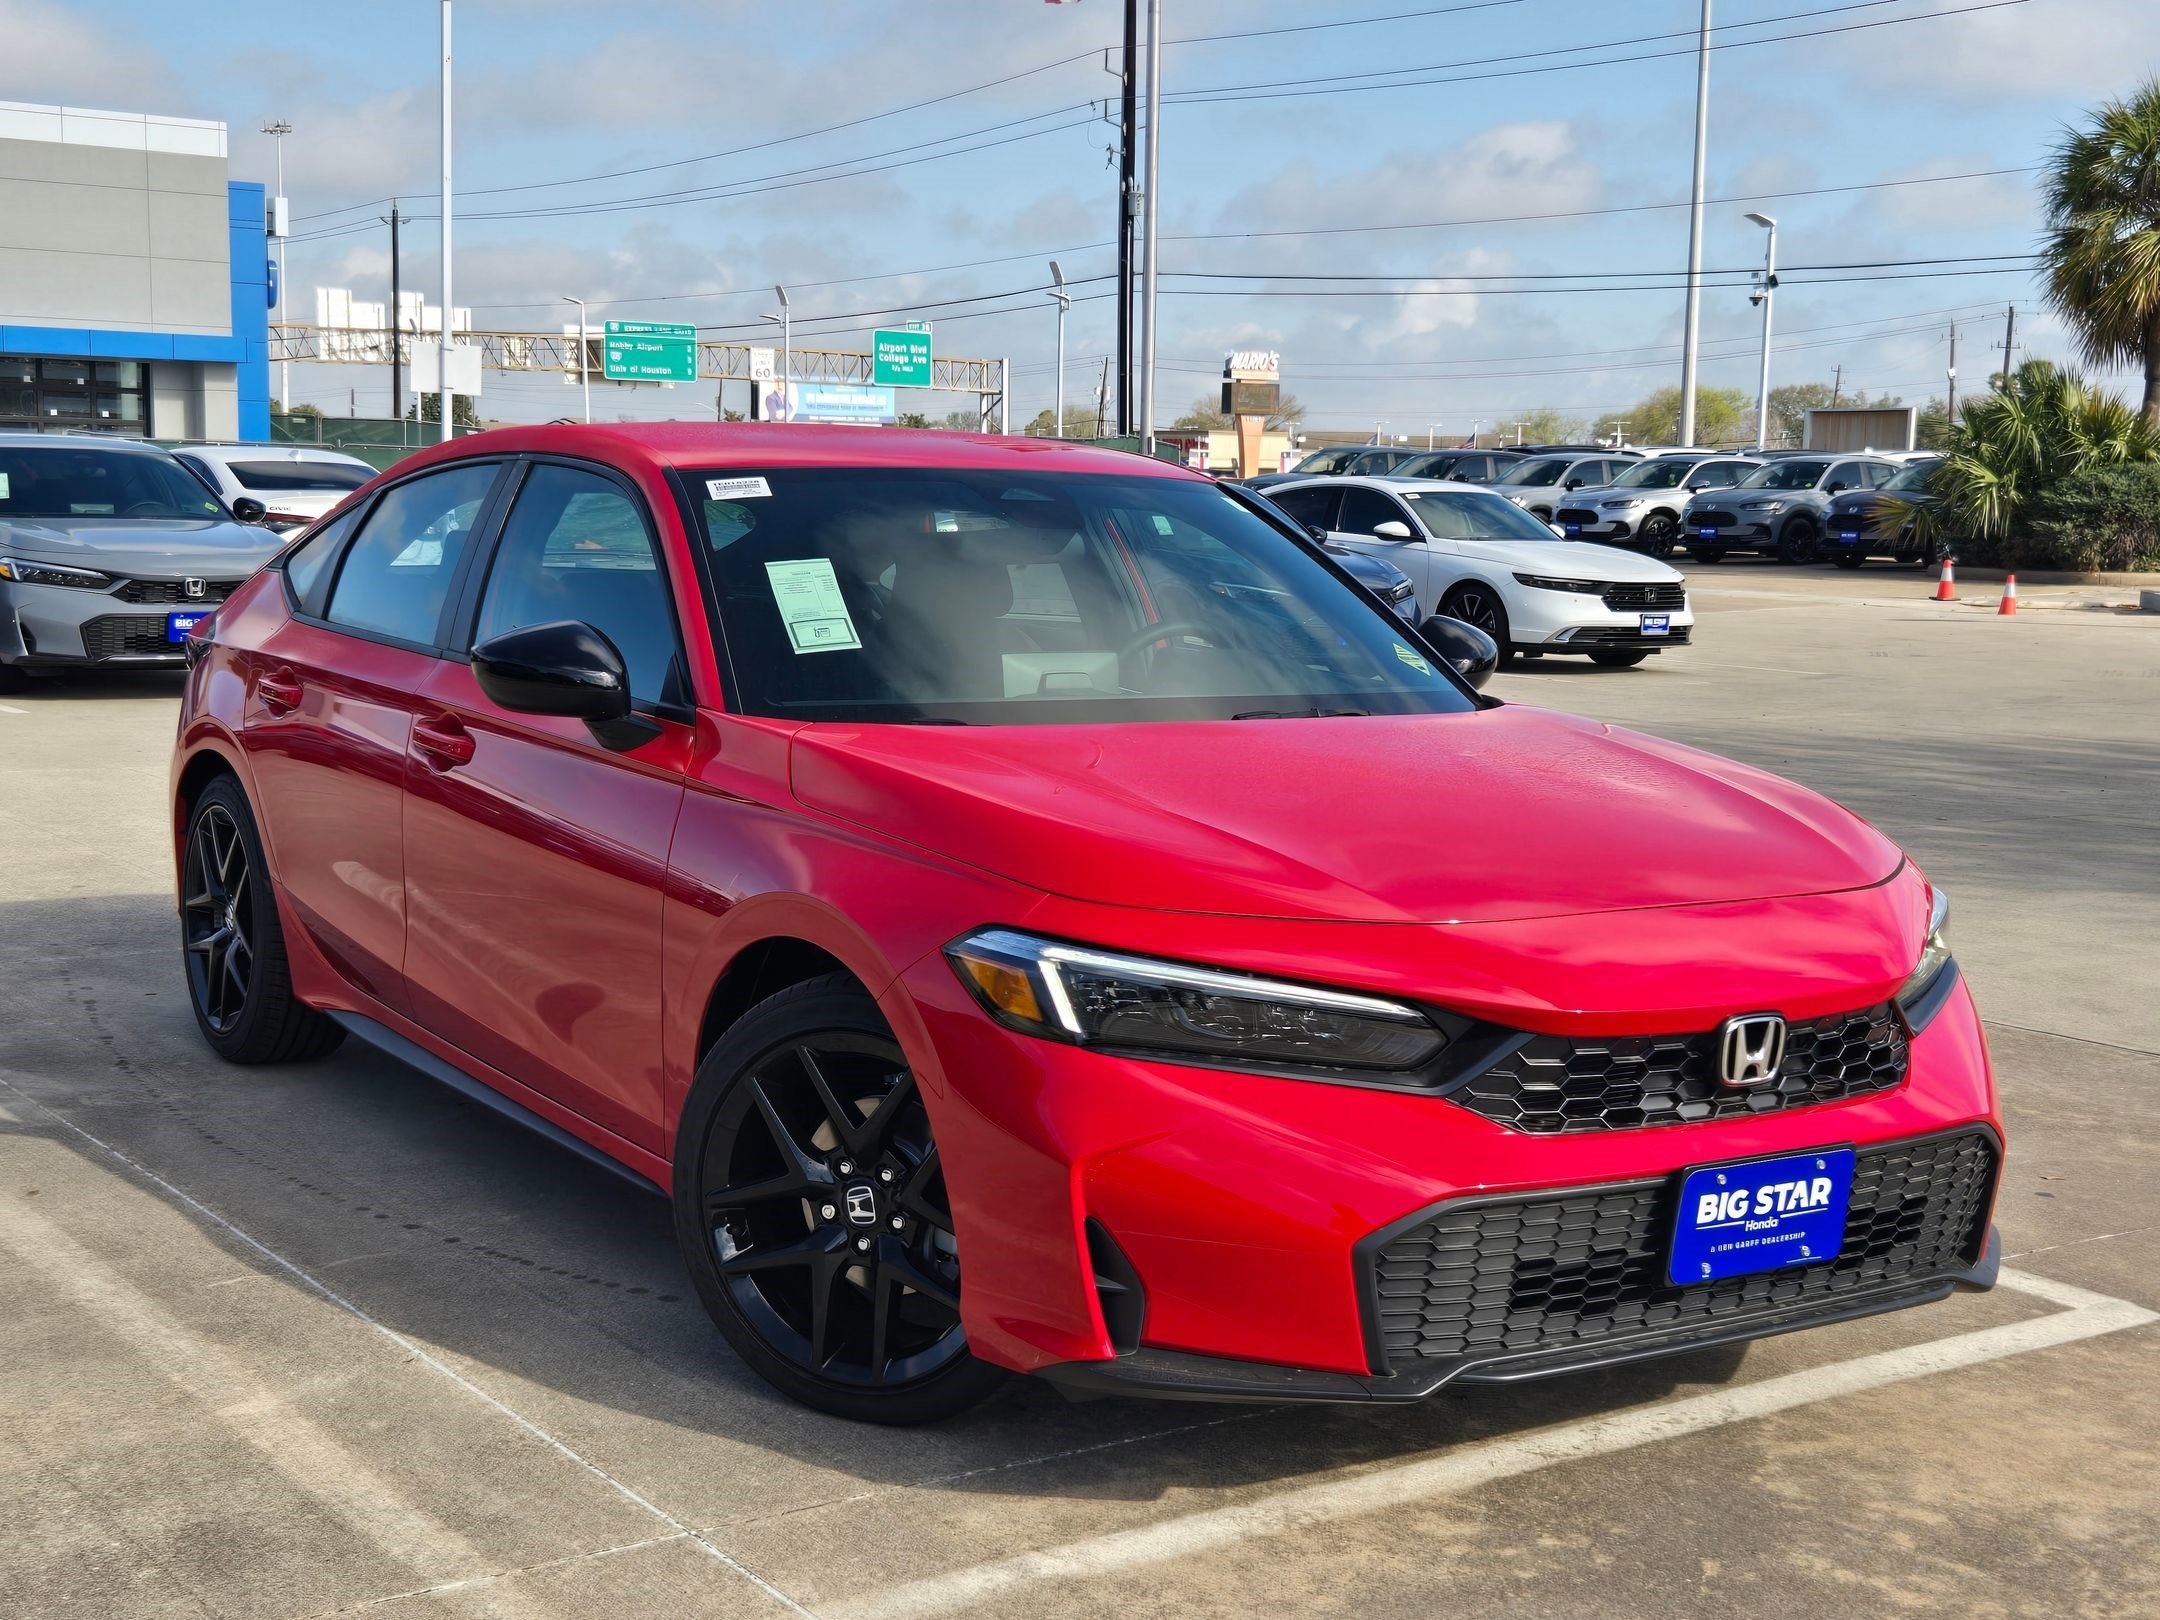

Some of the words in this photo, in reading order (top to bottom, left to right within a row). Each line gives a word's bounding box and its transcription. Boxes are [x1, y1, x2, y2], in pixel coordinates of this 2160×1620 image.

[609, 342, 634, 351] Hobby
[637, 343, 664, 352] Airport
[879, 342, 907, 353] Airport
[910, 344, 928, 354] Blvd
[878, 353, 909, 364] College
[912, 355, 927, 364] Ave
[1230, 350, 1280, 371] MARIO'S
[610, 364, 627, 373] Univ
[630, 365, 638, 373] of
[641, 366, 672, 375] Houston
[756, 368, 771, 378] 60
[175, 618, 193, 627] BIG
[1695, 1189, 1750, 1225] BIG
[1753, 1177, 1833, 1215] STAR
[1744, 1215, 1779, 1232] Honda
[1761, 1231, 1807, 1246] DEALERSHIP
